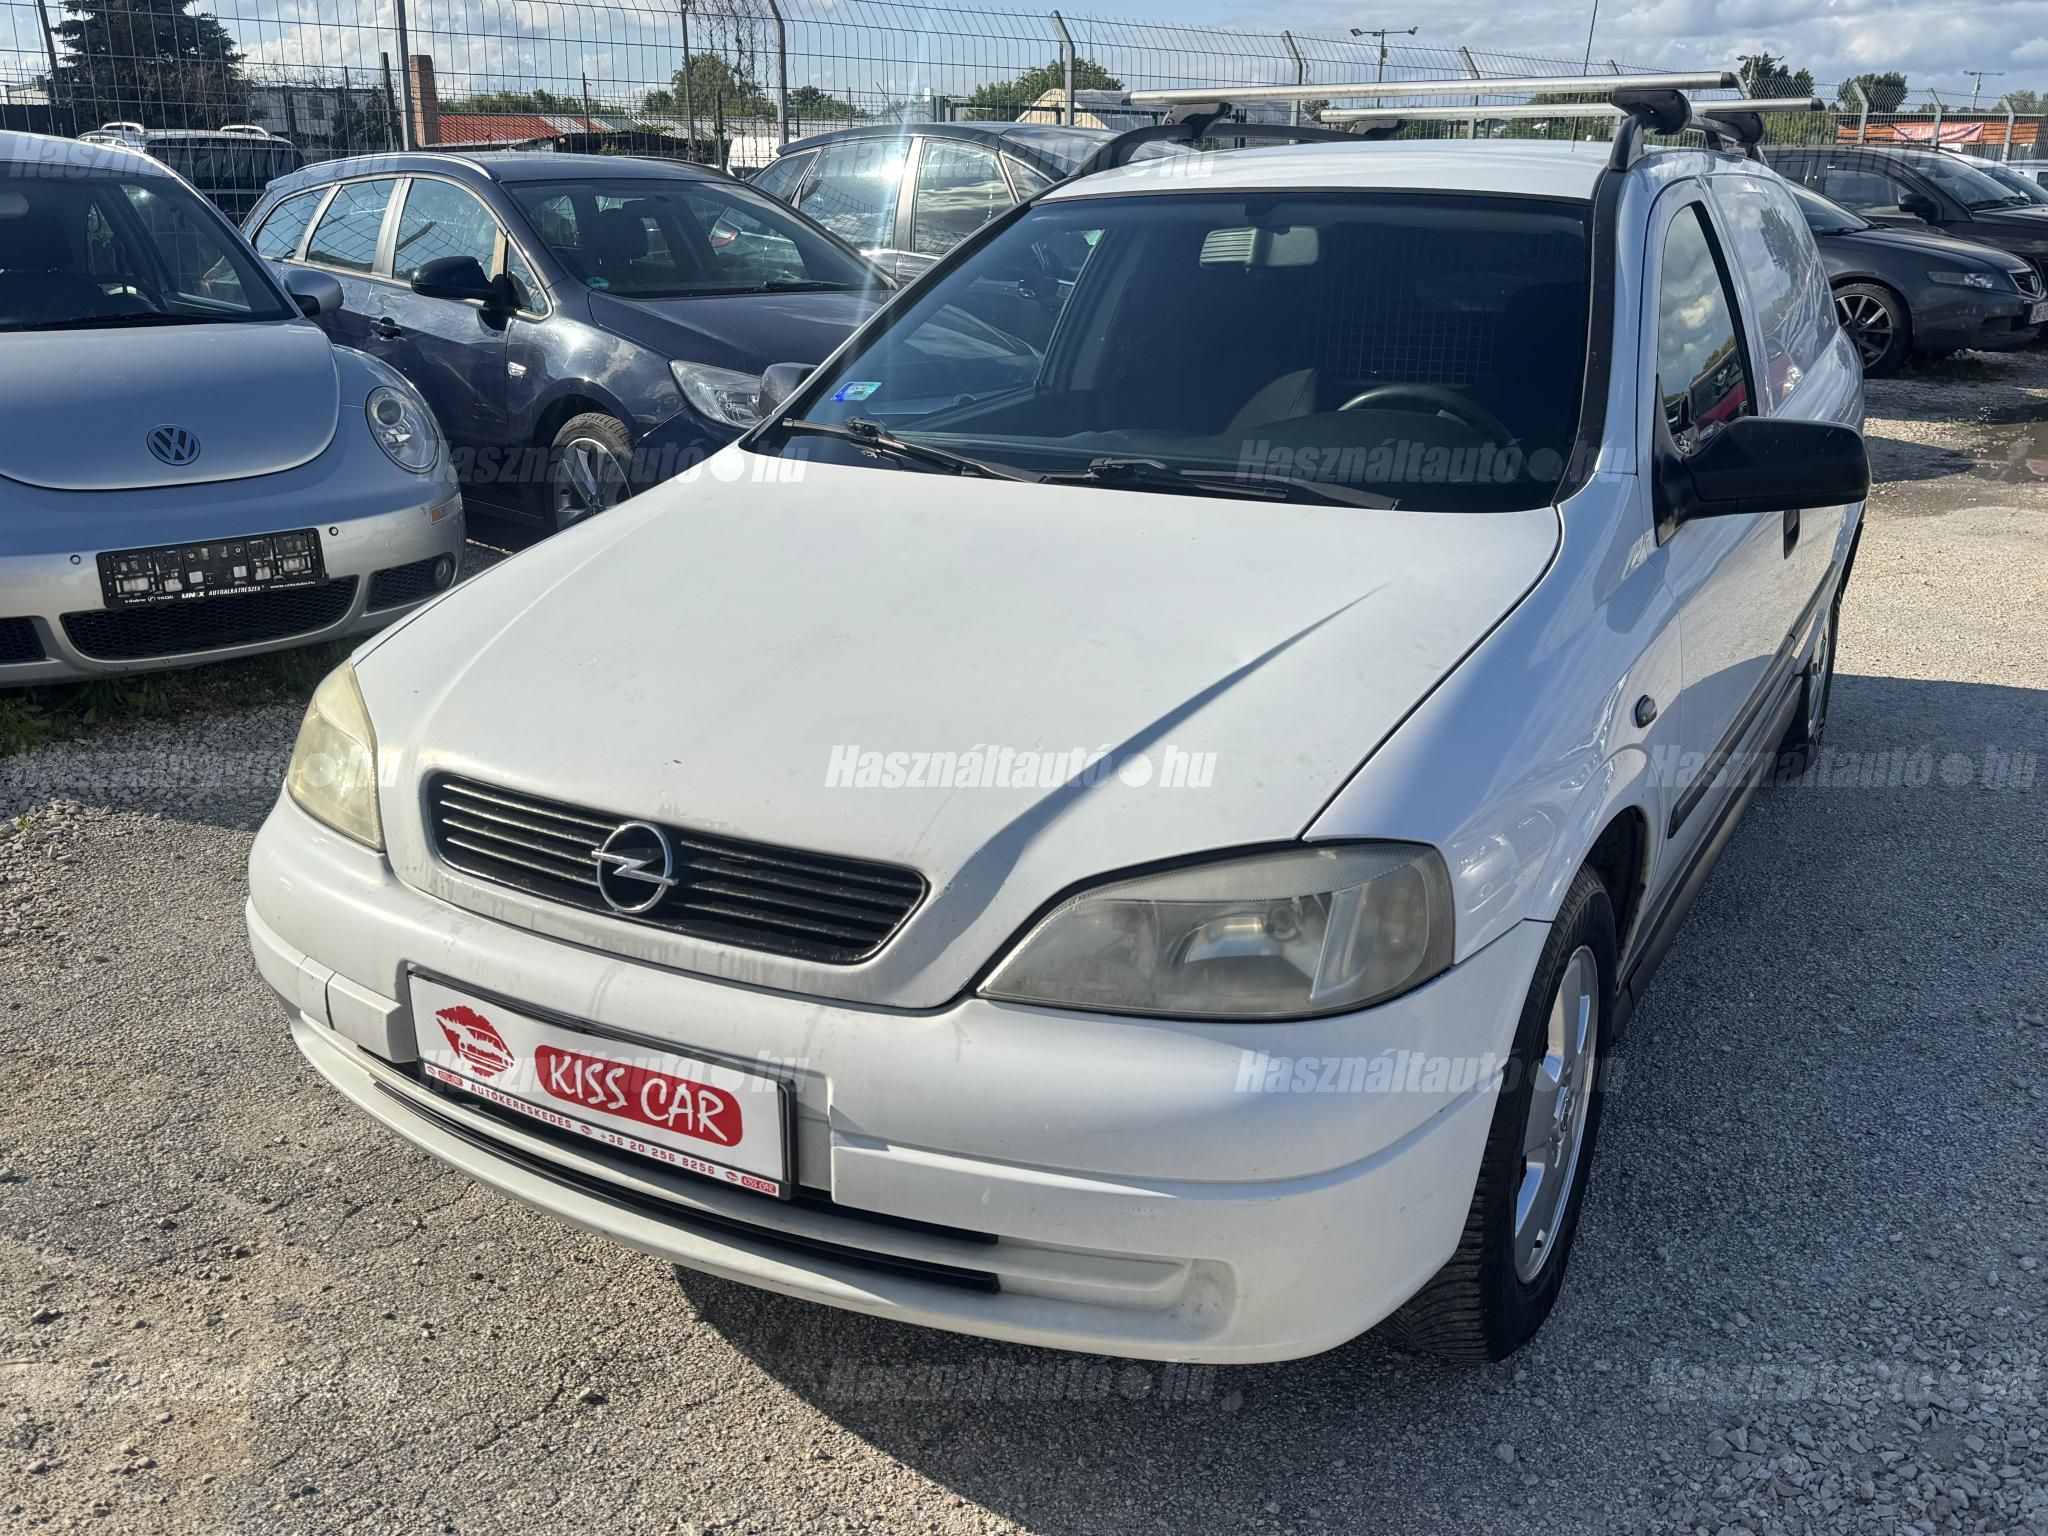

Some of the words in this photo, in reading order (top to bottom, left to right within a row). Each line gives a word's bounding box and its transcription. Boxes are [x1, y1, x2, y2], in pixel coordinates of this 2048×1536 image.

[550, 1054, 628, 1110] KISS
[640, 1078, 728, 1142] CAR
[600, 1133, 624, 1146] +36
[630, 1141, 645, 1153] 20
[651, 1147, 676, 1163] 256
[681, 1157, 716, 1176] 8256
[743, 1176, 758, 1188] KISS
[759, 1182, 775, 1193] CAR
